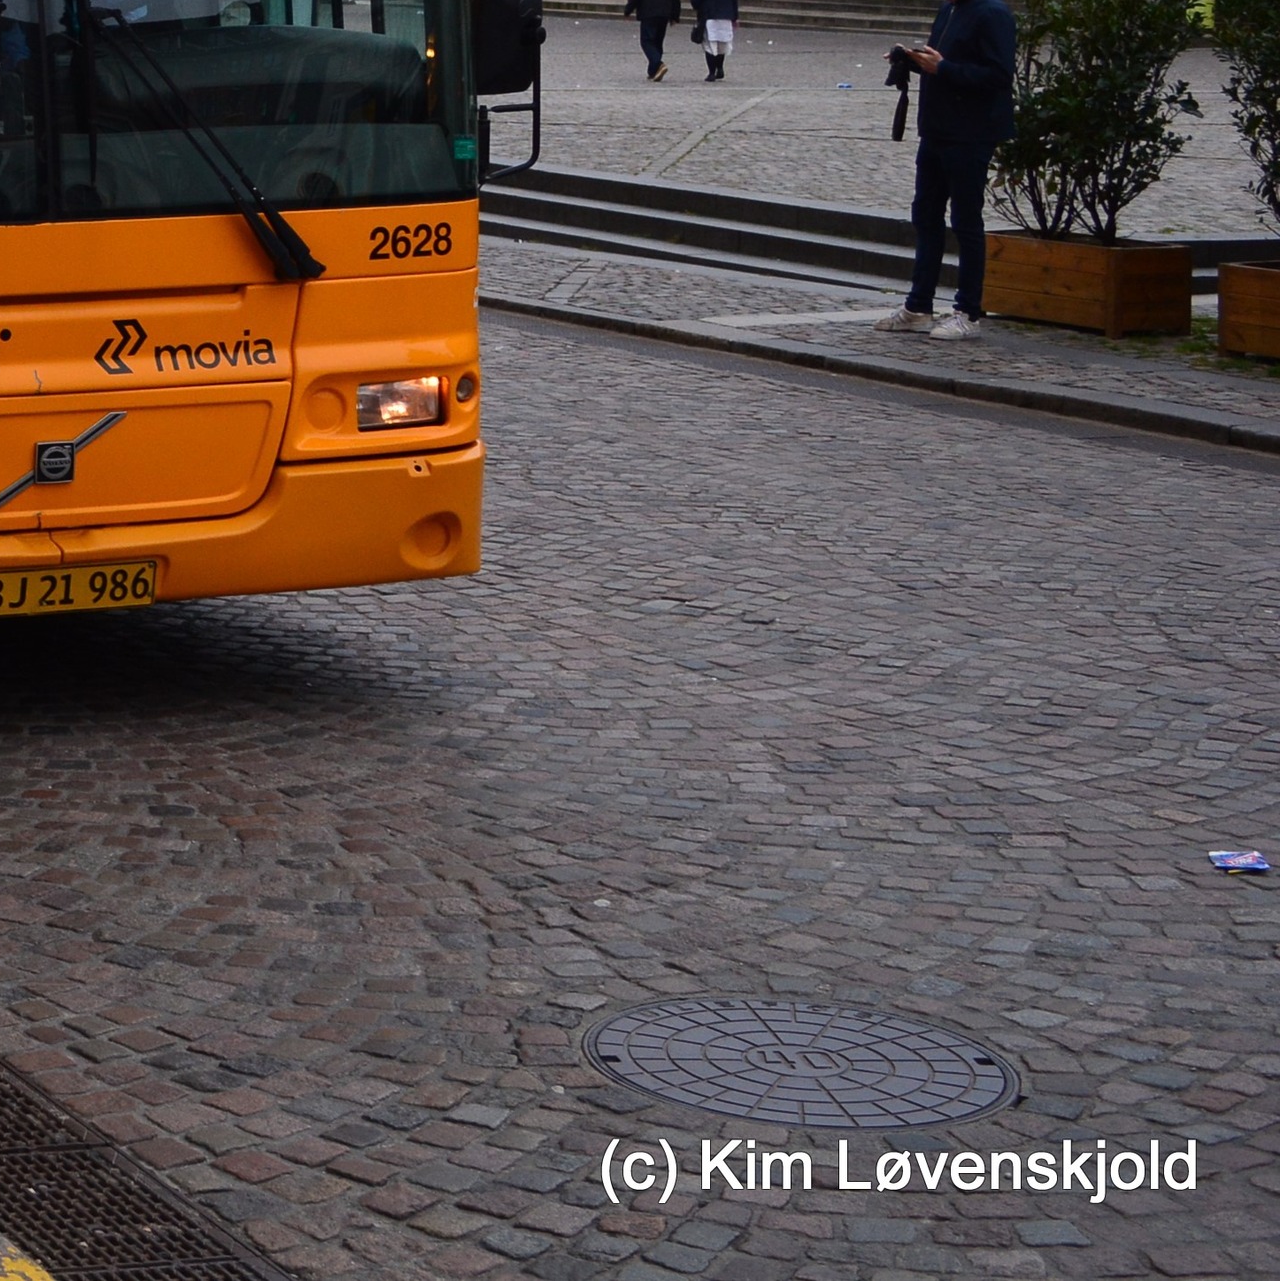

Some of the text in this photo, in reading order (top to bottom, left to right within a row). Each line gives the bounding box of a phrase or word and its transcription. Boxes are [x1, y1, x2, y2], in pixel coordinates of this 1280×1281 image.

[369, 222, 452, 260] 2628
[154, 329, 277, 372] movia
[38, 574, 74, 606] 21
[89, 567, 150, 603] 986
